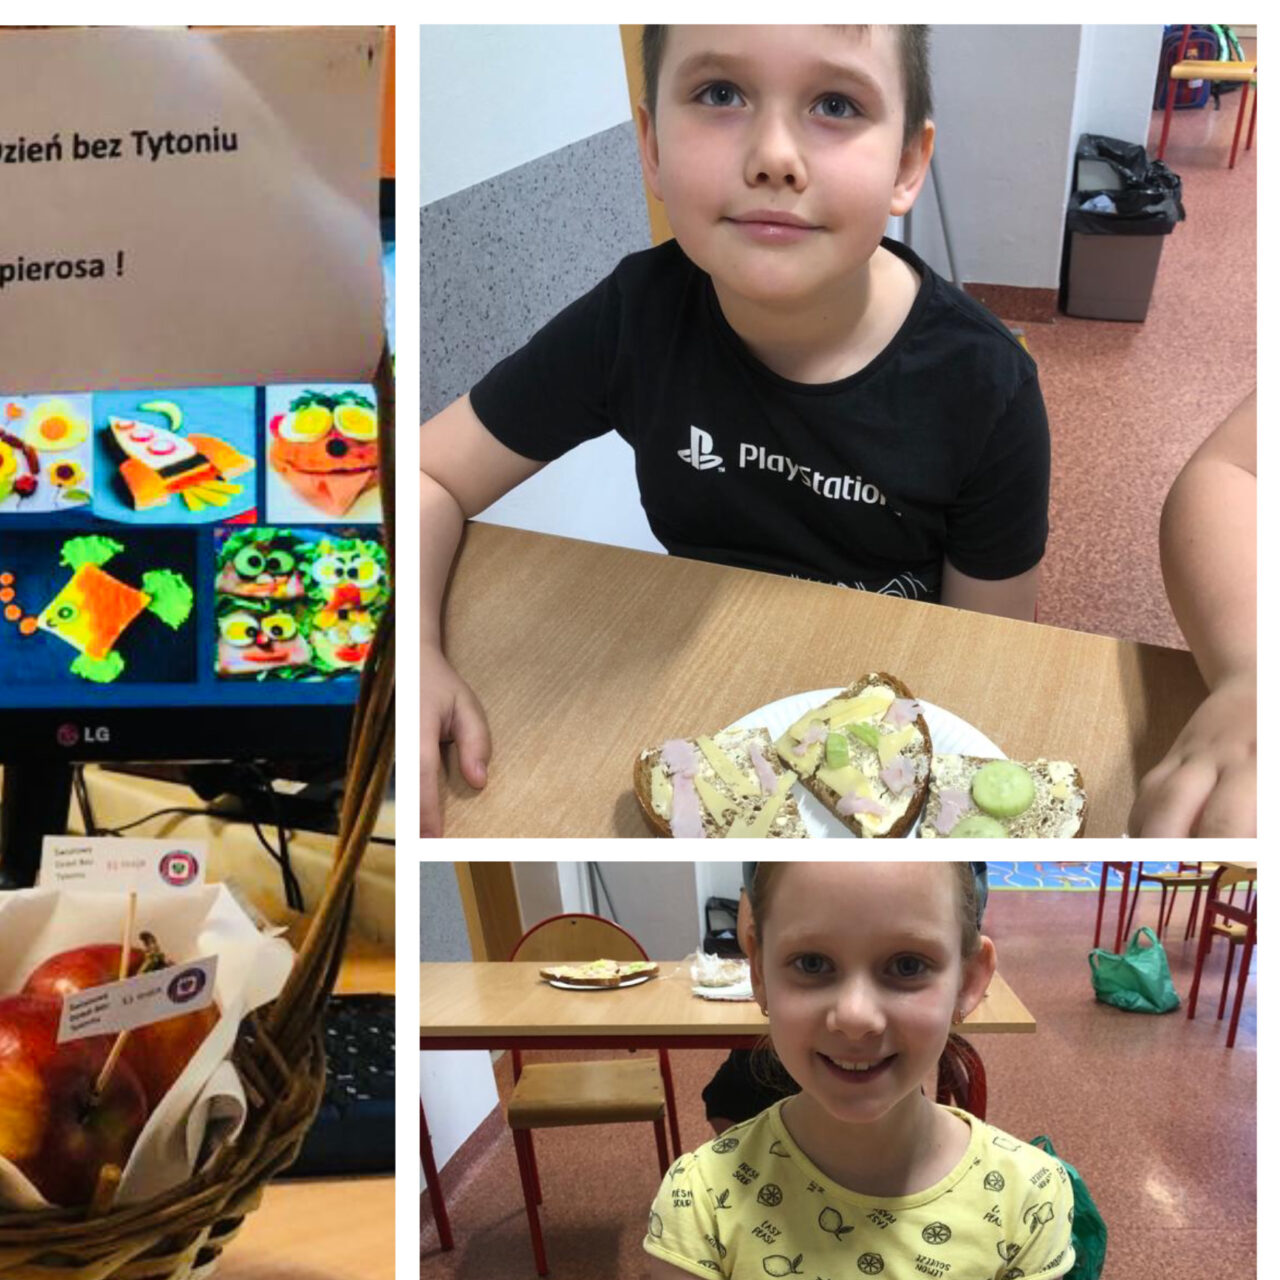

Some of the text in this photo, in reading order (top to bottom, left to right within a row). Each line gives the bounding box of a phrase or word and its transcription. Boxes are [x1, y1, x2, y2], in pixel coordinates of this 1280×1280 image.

[73, 133, 123, 160] bez
[131, 127, 239, 161] Tytoniu
[84, 726, 110, 742] LG
